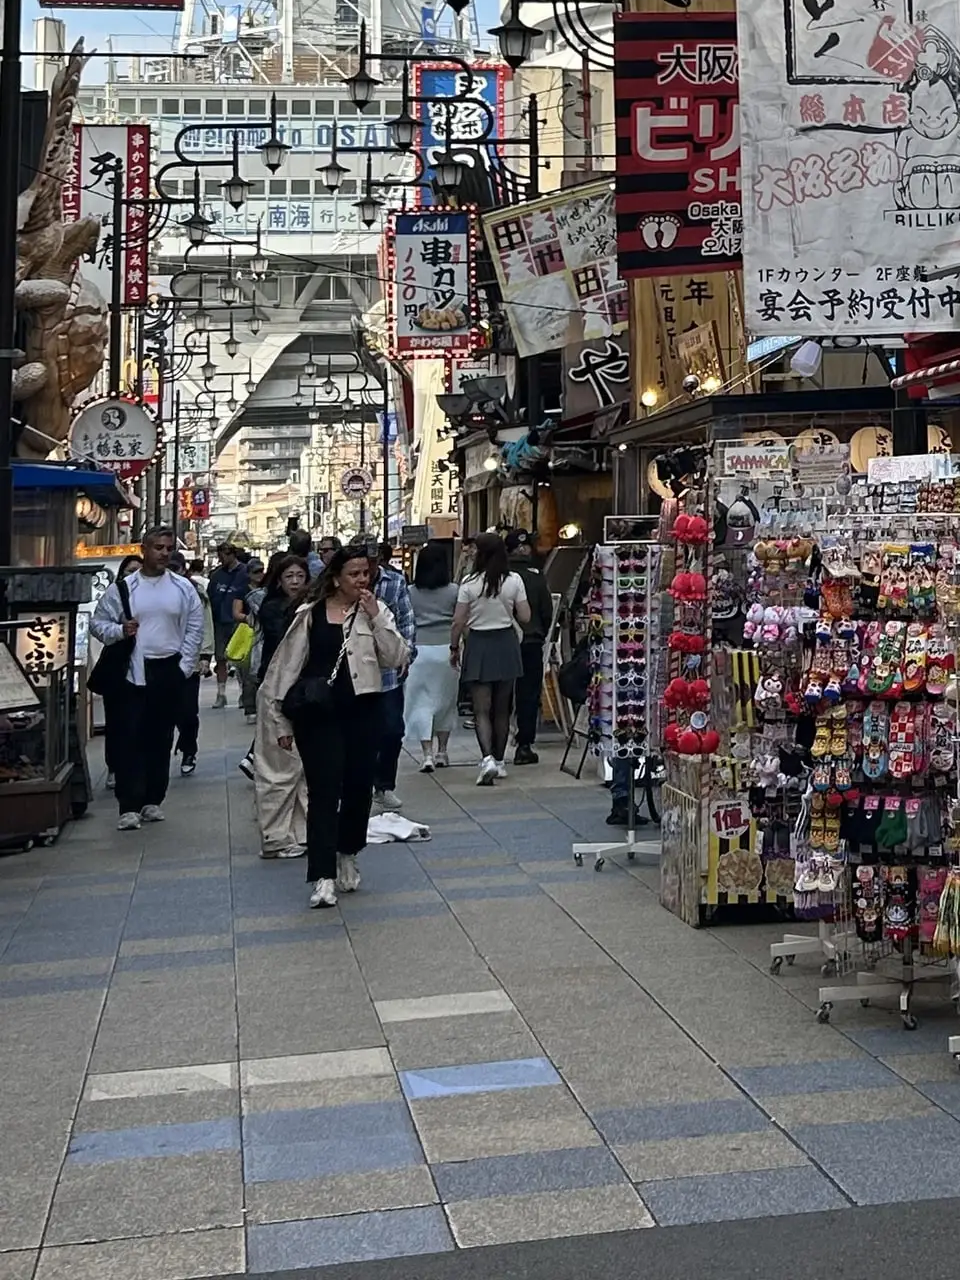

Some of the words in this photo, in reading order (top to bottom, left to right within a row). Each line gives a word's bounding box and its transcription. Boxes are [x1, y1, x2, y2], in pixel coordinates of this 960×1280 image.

[657, 42, 740, 85] 大阪
[799, 93, 908, 125] 総本店
[184, 125, 266, 148] Welcome
[278, 123, 302, 147] to
[754, 140, 901, 211] 大阪名物
[268, 204, 311, 228] 南海
[689, 201, 737, 219] Osaka
[412, 217, 449, 233] Asahi
[420, 236, 456, 310] 串カツ
